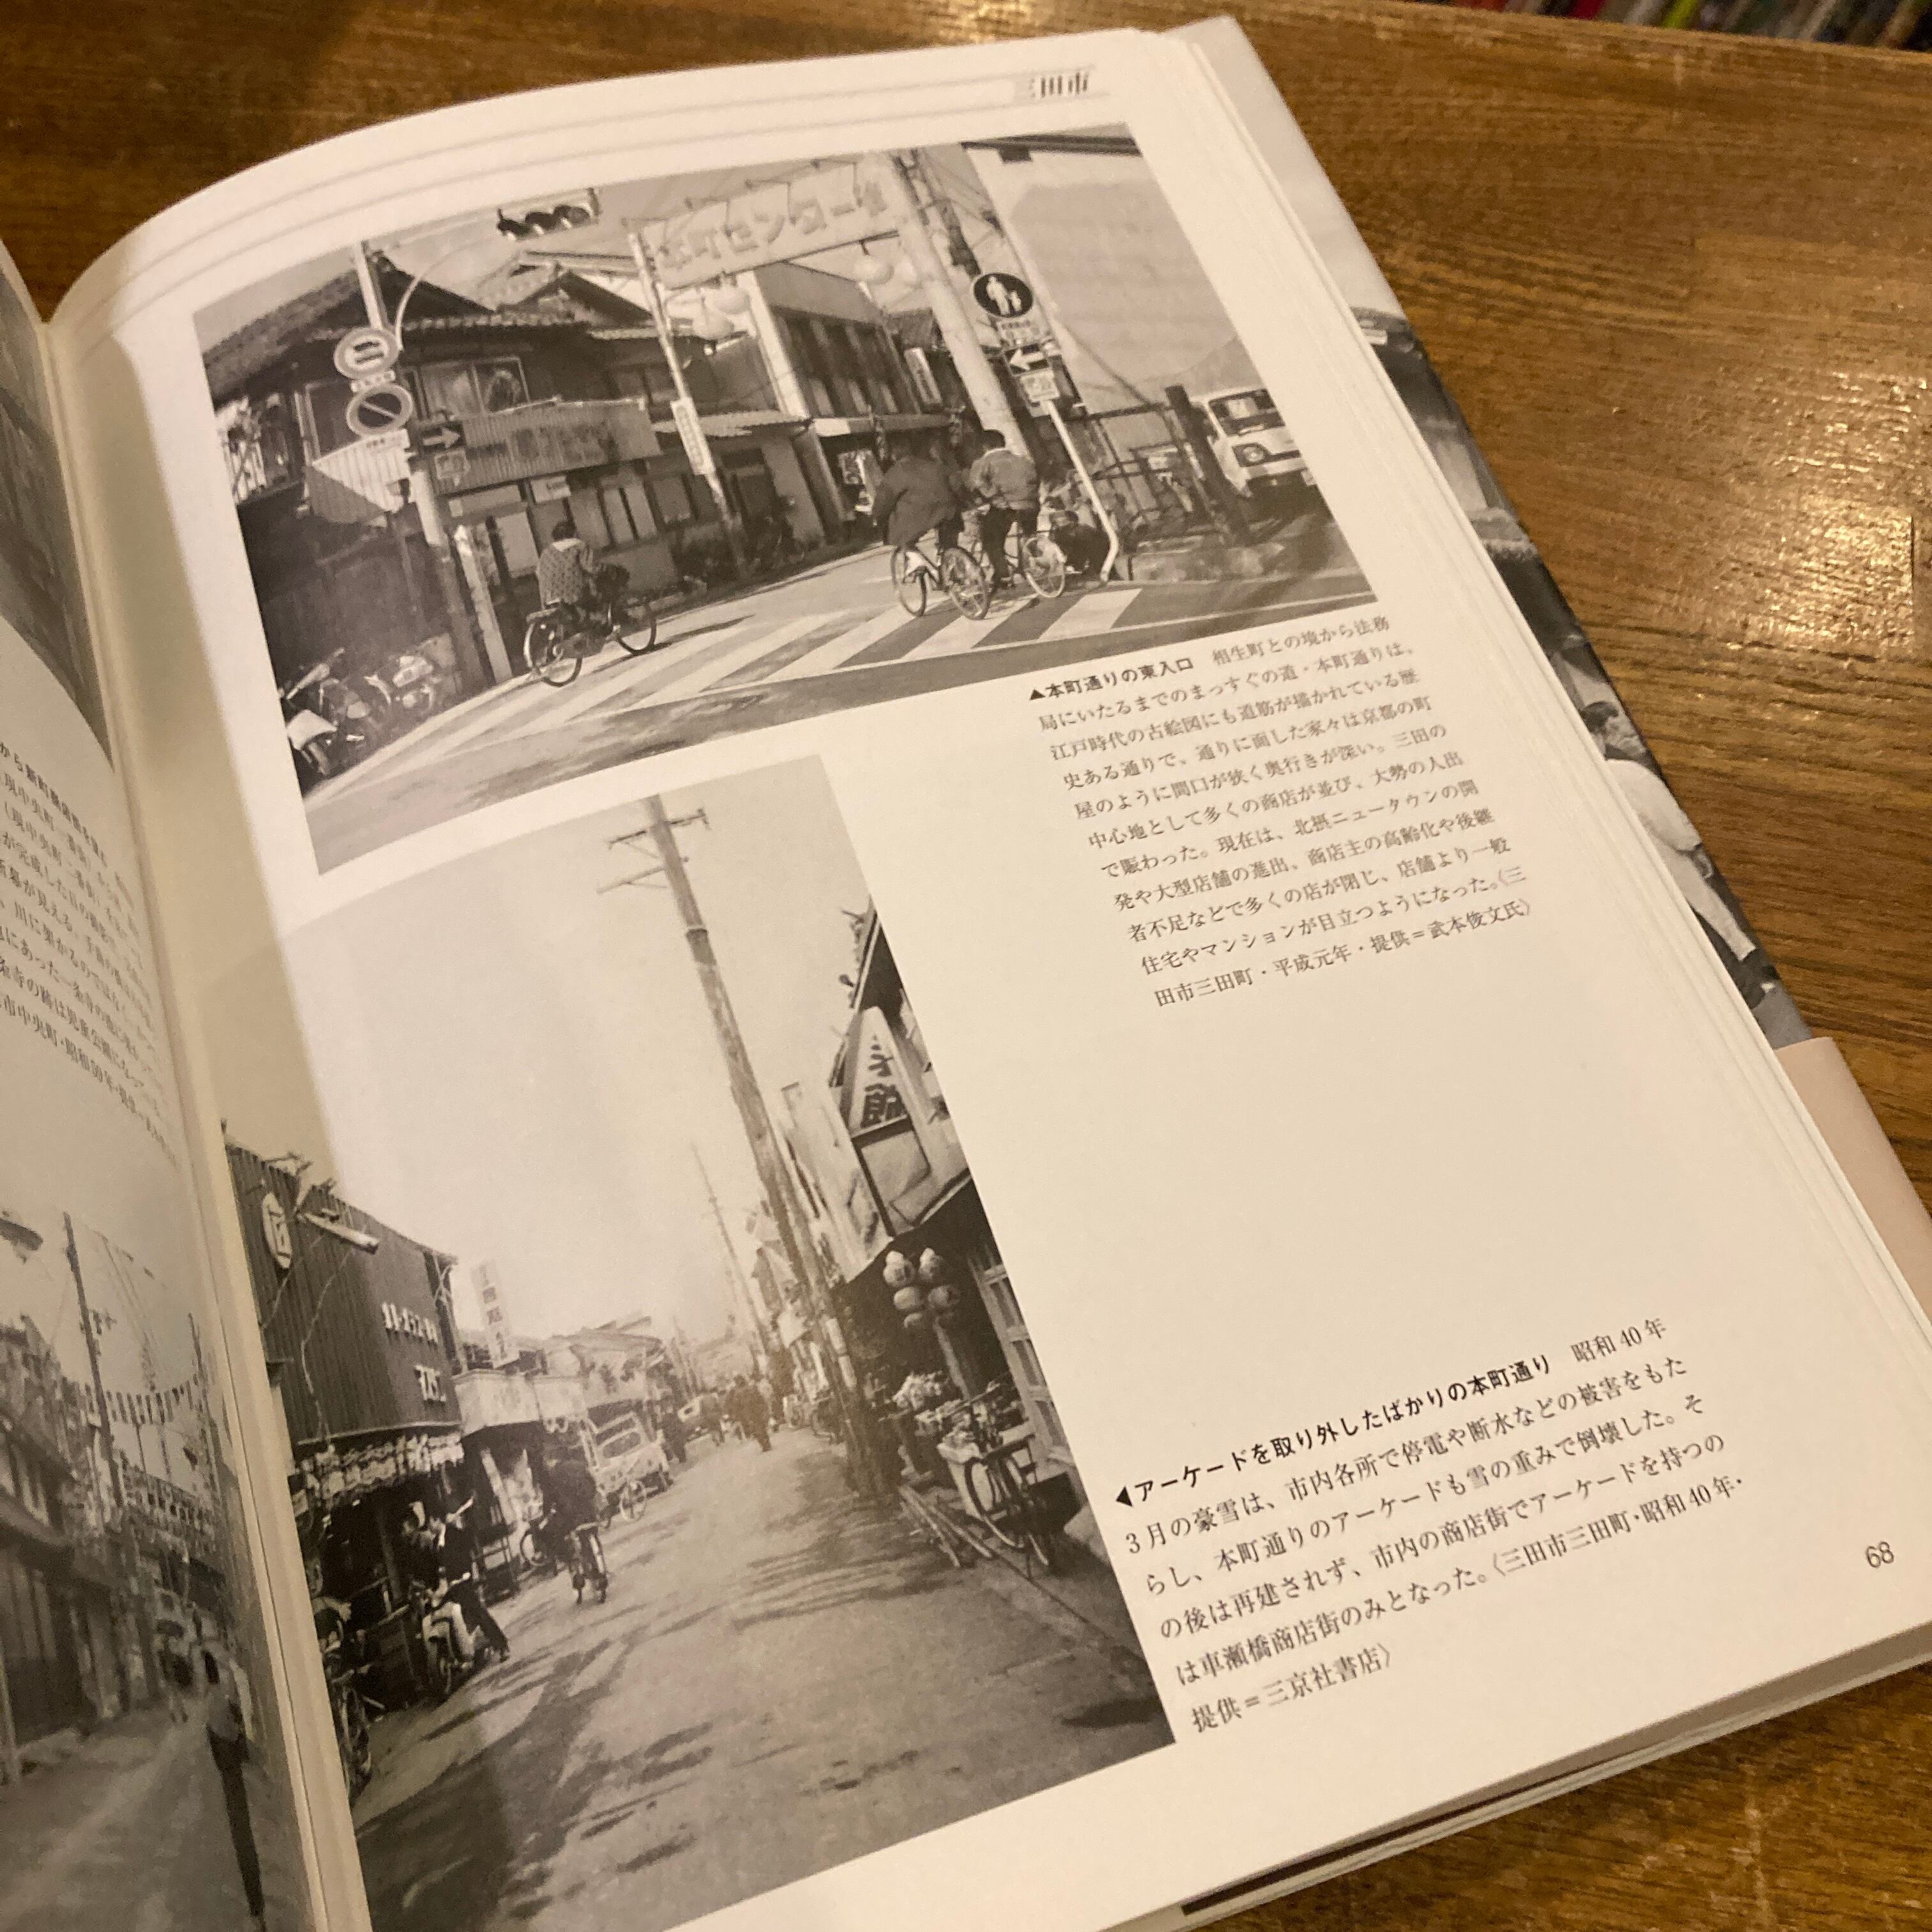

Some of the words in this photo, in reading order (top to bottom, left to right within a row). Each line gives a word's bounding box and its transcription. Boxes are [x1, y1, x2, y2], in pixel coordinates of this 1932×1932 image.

[1046, 657, 1193, 700] 本町通りの東入口
[1212, 616, 1390, 667] 相生町との境から法務
[1134, 1354, 1550, 1503] アーケードを取り外したばかりの本町通り
[1161, 1434, 1725, 1639] の後は再建されず、市内の商店街でアーケードを持つの
[1866, 1541, 1894, 1568] 68
